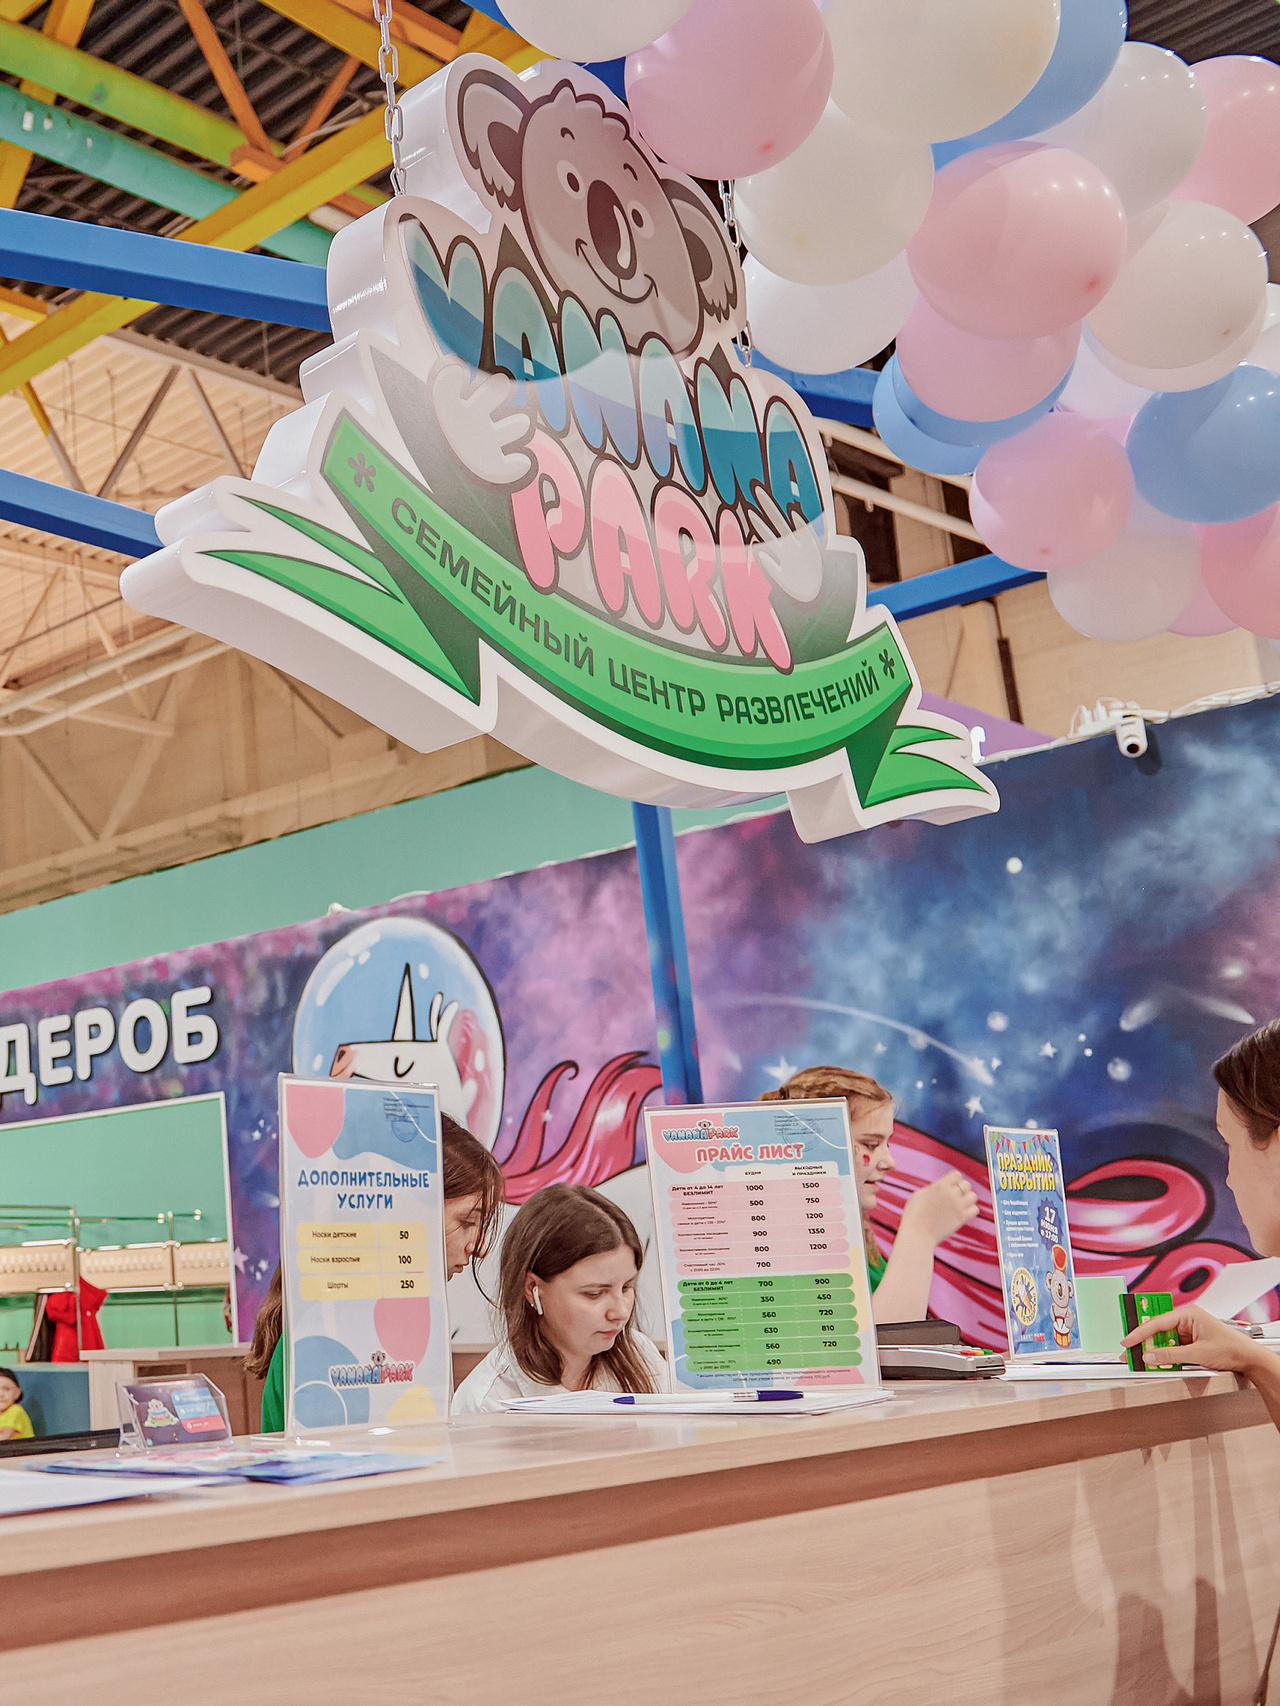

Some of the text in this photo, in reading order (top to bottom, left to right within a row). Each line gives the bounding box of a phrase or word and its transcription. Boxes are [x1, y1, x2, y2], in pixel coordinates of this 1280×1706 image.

[510, 430, 795, 676] PARK
[391, 497, 880, 726] СЕМЕЙНЫЙ ЦЕНТР РАЗВЛЕЧЕНИЙ
[707, 1127, 739, 1139] PARK
[696, 1144, 804, 1162] ПРАЙС ЛИСТ
[996, 1152, 1053, 1173] ПРАЗДНИК
[298, 1169, 430, 1188] ДОПОЛНИТЕЛЬНЫЕ
[1000, 1171, 1056, 1191] ОТКРЫТИЯ
[337, 1193, 393, 1209] УСЛУГИ
[1044, 1206, 1056, 1224] 17
[399, 1231, 409, 1240] 50
[331, 1256, 361, 1264] взрослые
[398, 1255, 412, 1264] 100
[327, 1282, 349, 1290] Шорты
[400, 1280, 415, 1289] 250
[380, 1362, 414, 1384] PARK
